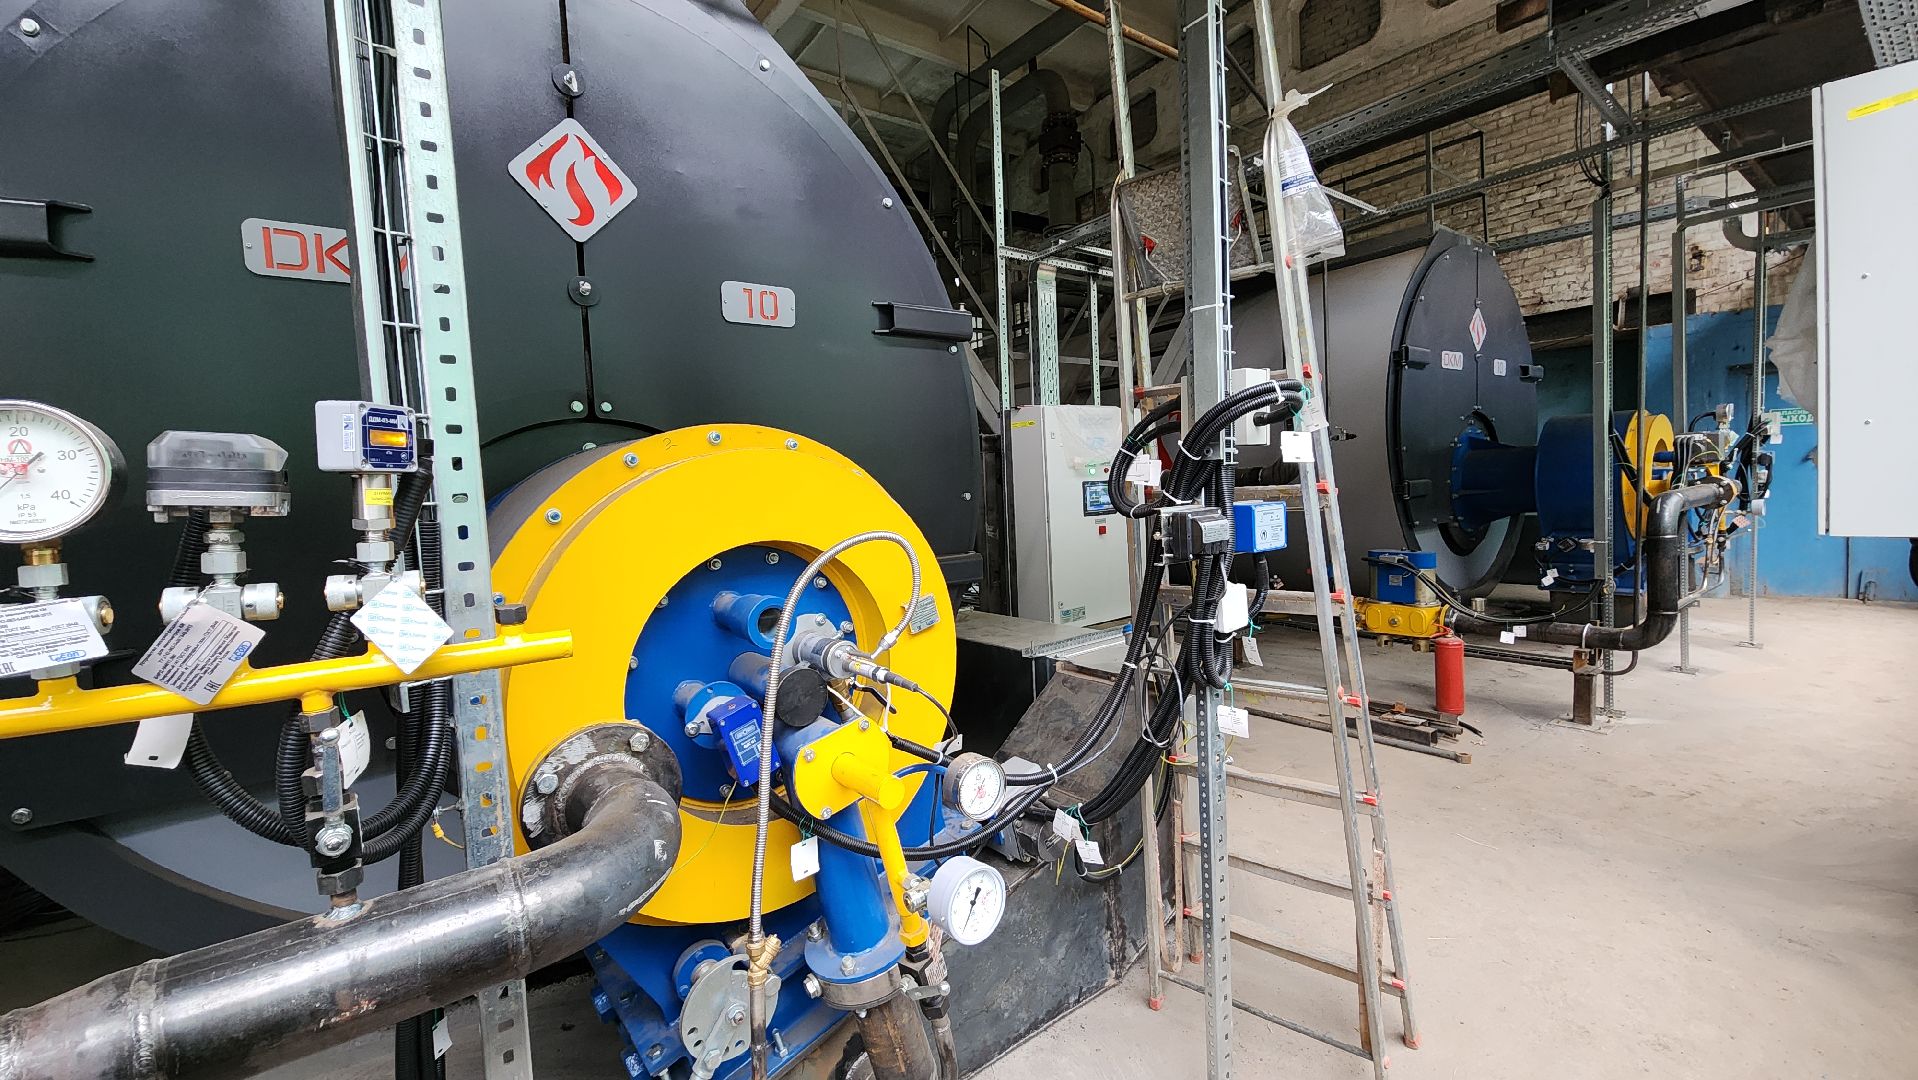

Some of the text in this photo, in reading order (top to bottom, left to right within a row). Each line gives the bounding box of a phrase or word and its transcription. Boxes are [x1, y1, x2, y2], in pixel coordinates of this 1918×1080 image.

[262, 226, 408, 275] DK
[743, 287, 778, 320] 10
[1443, 353, 1461, 367] DKM
[9, 426, 29, 437] 20
[56, 449, 77, 461] 30
[50, 489, 71, 501] 40
